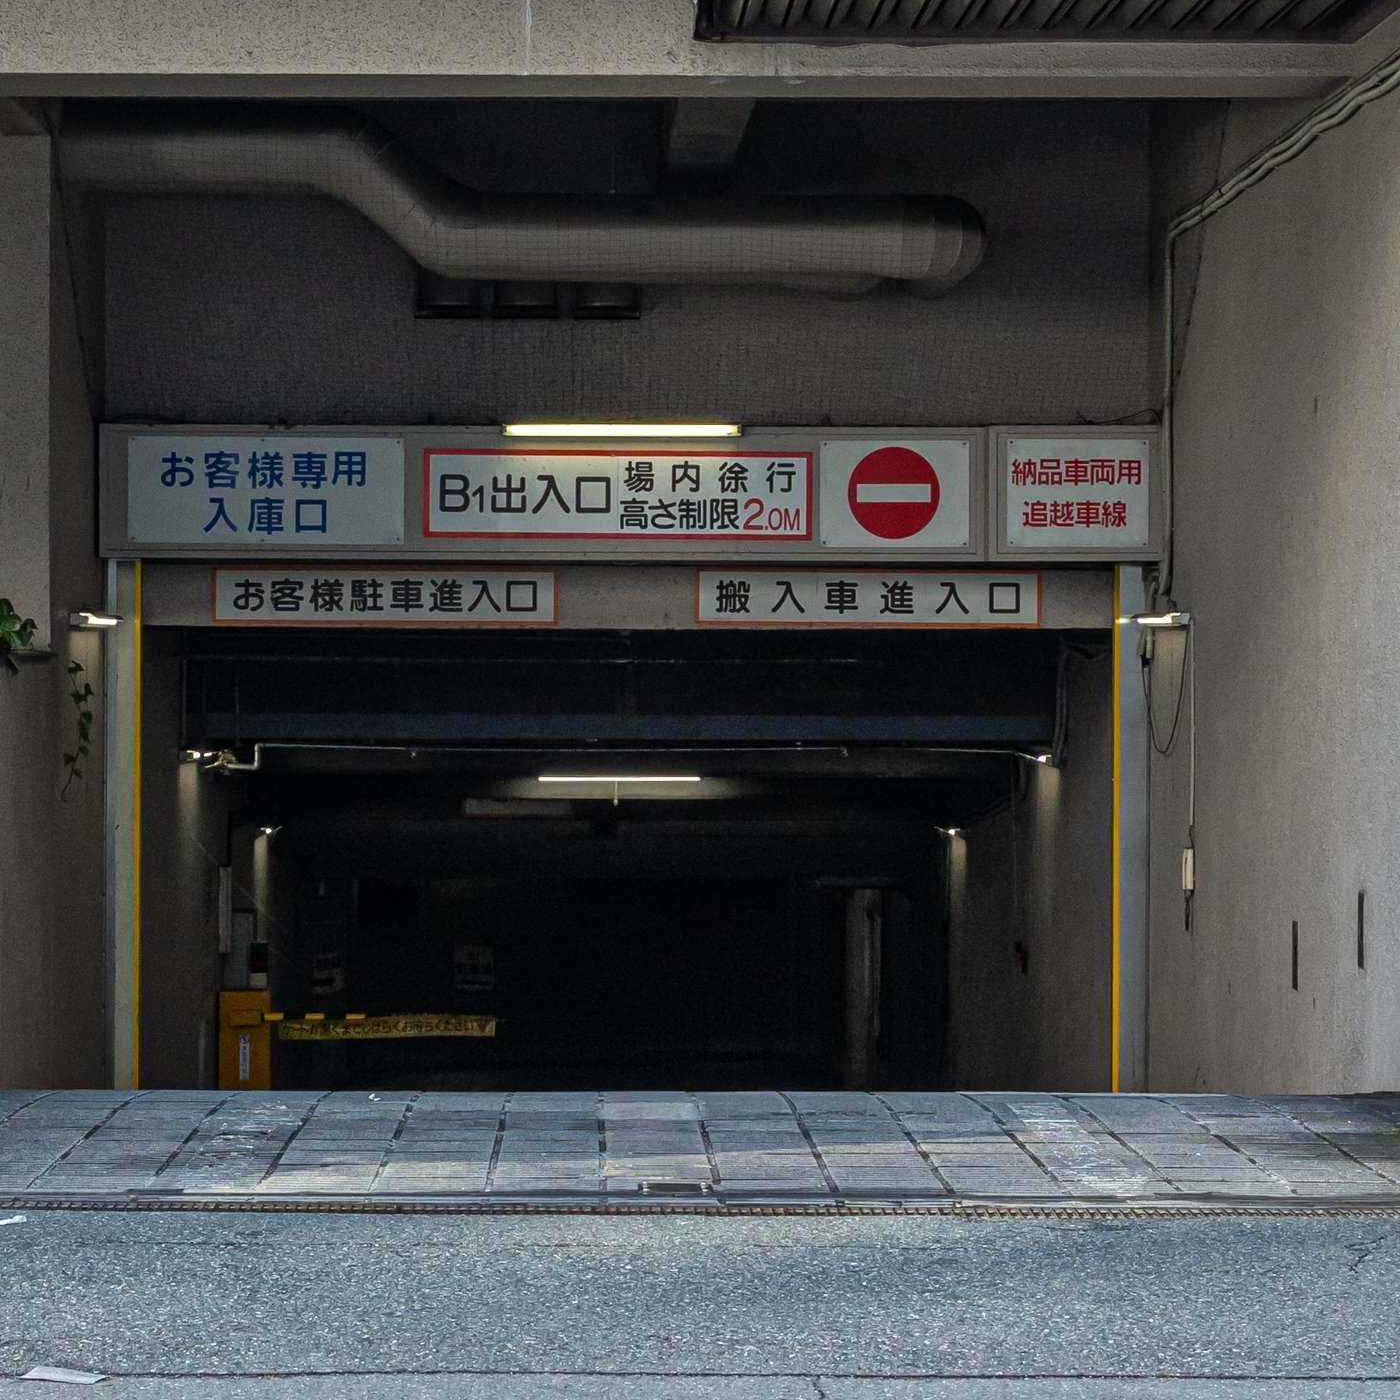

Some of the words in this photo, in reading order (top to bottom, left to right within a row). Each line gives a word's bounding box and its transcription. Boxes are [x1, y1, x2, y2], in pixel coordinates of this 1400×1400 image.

[160, 450, 368, 489] お客様専用
[624, 460, 797, 494] 場内徐行
[1011, 458, 1143, 487] 納品車両用
[438, 473, 613, 514] B1出入口
[202, 496, 329, 535] 入庫口
[1022, 500, 1128, 528] 追越車線
[232, 578, 538, 614] お客様駐車進入口
[715, 580, 1022, 616] 搬入車進入口
